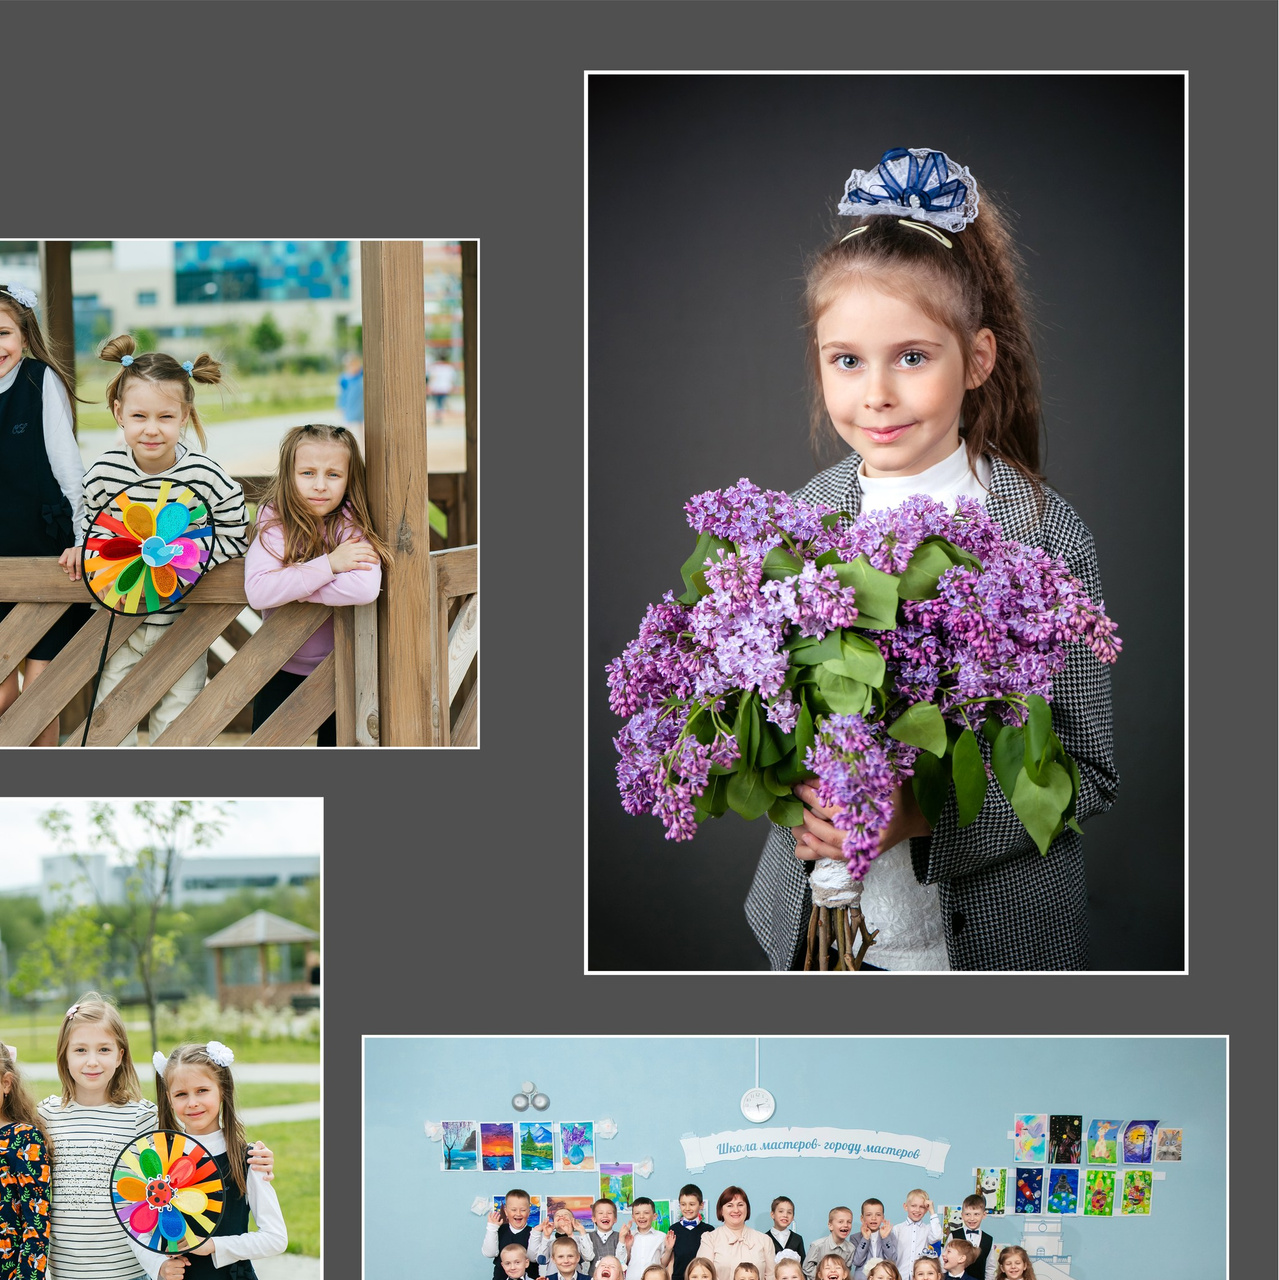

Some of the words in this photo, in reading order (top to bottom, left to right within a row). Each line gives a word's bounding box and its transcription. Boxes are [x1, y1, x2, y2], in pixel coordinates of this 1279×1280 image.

[716, 1142, 757, 1155] Школа
[824, 1141, 862, 1155] городу
[863, 1144, 921, 1159] мастеров
